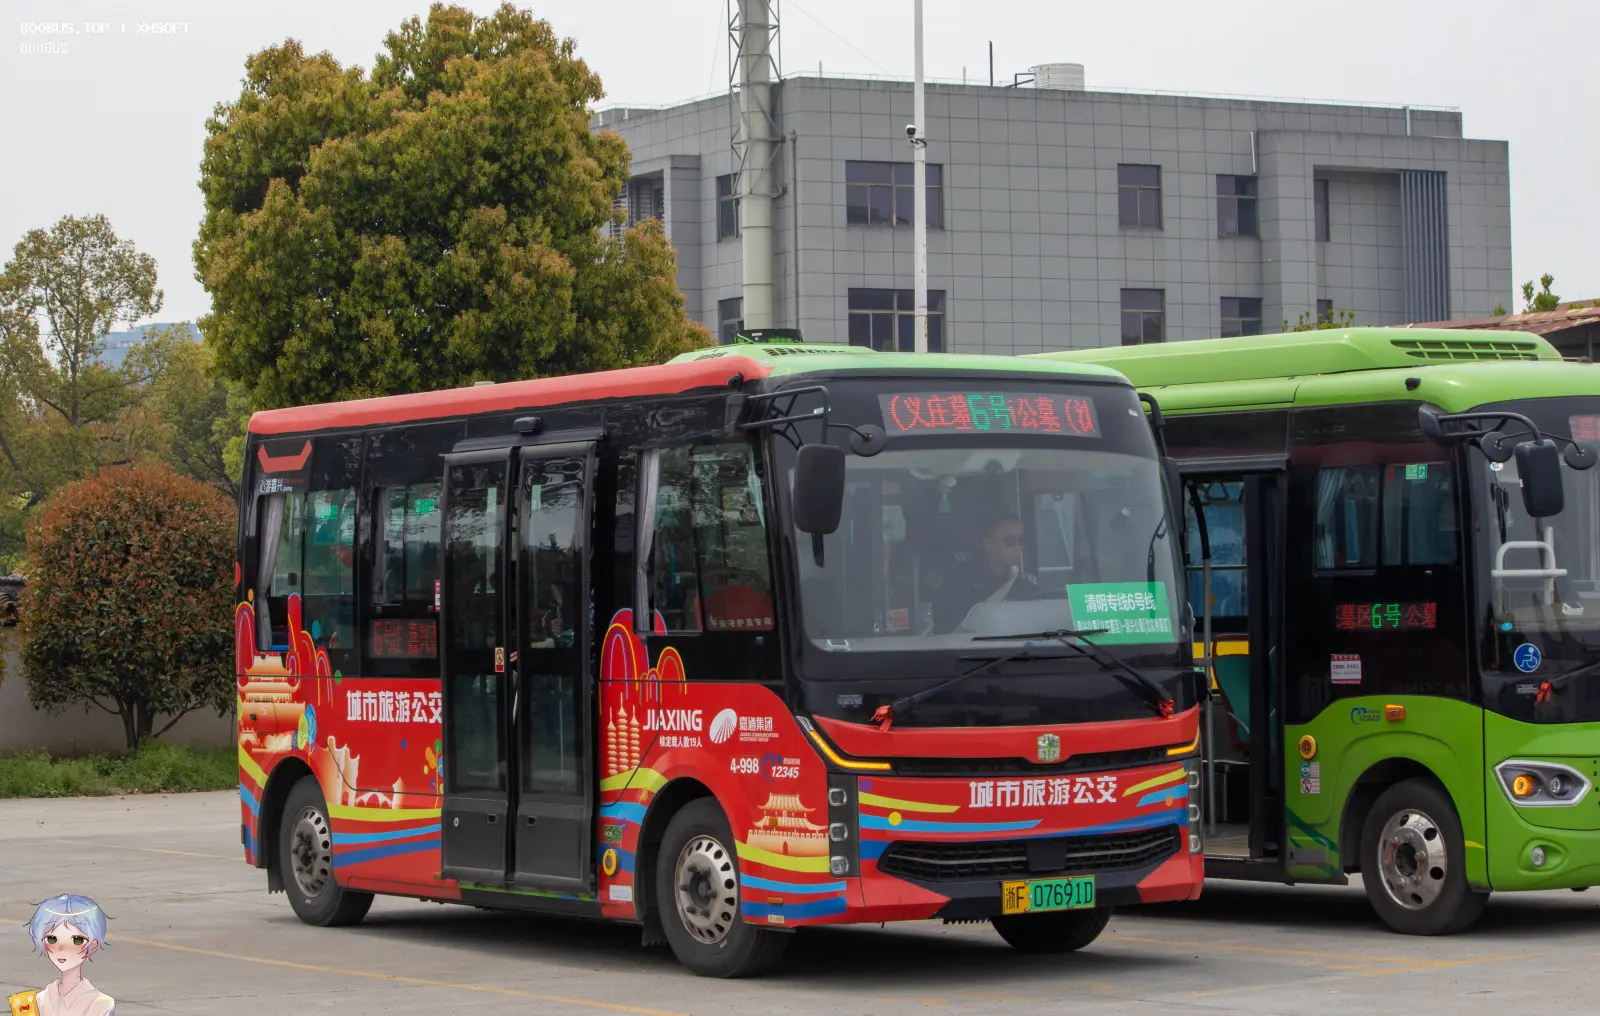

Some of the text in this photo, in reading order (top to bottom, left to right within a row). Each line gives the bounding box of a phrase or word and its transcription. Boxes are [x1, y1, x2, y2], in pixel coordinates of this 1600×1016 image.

[1084, 592, 1156, 612] 清明专线6号线
[346, 690, 443, 724] 城市旅游公交
[643, 709, 703, 732] JIAXING
[739, 716, 773, 732] 嘉通集团
[659, 735, 703, 748] 核定载人数19人
[730, 757, 759, 774] 4-998
[771, 765, 800, 779] 12345
[969, 775, 1117, 809] 城市旅游公交
